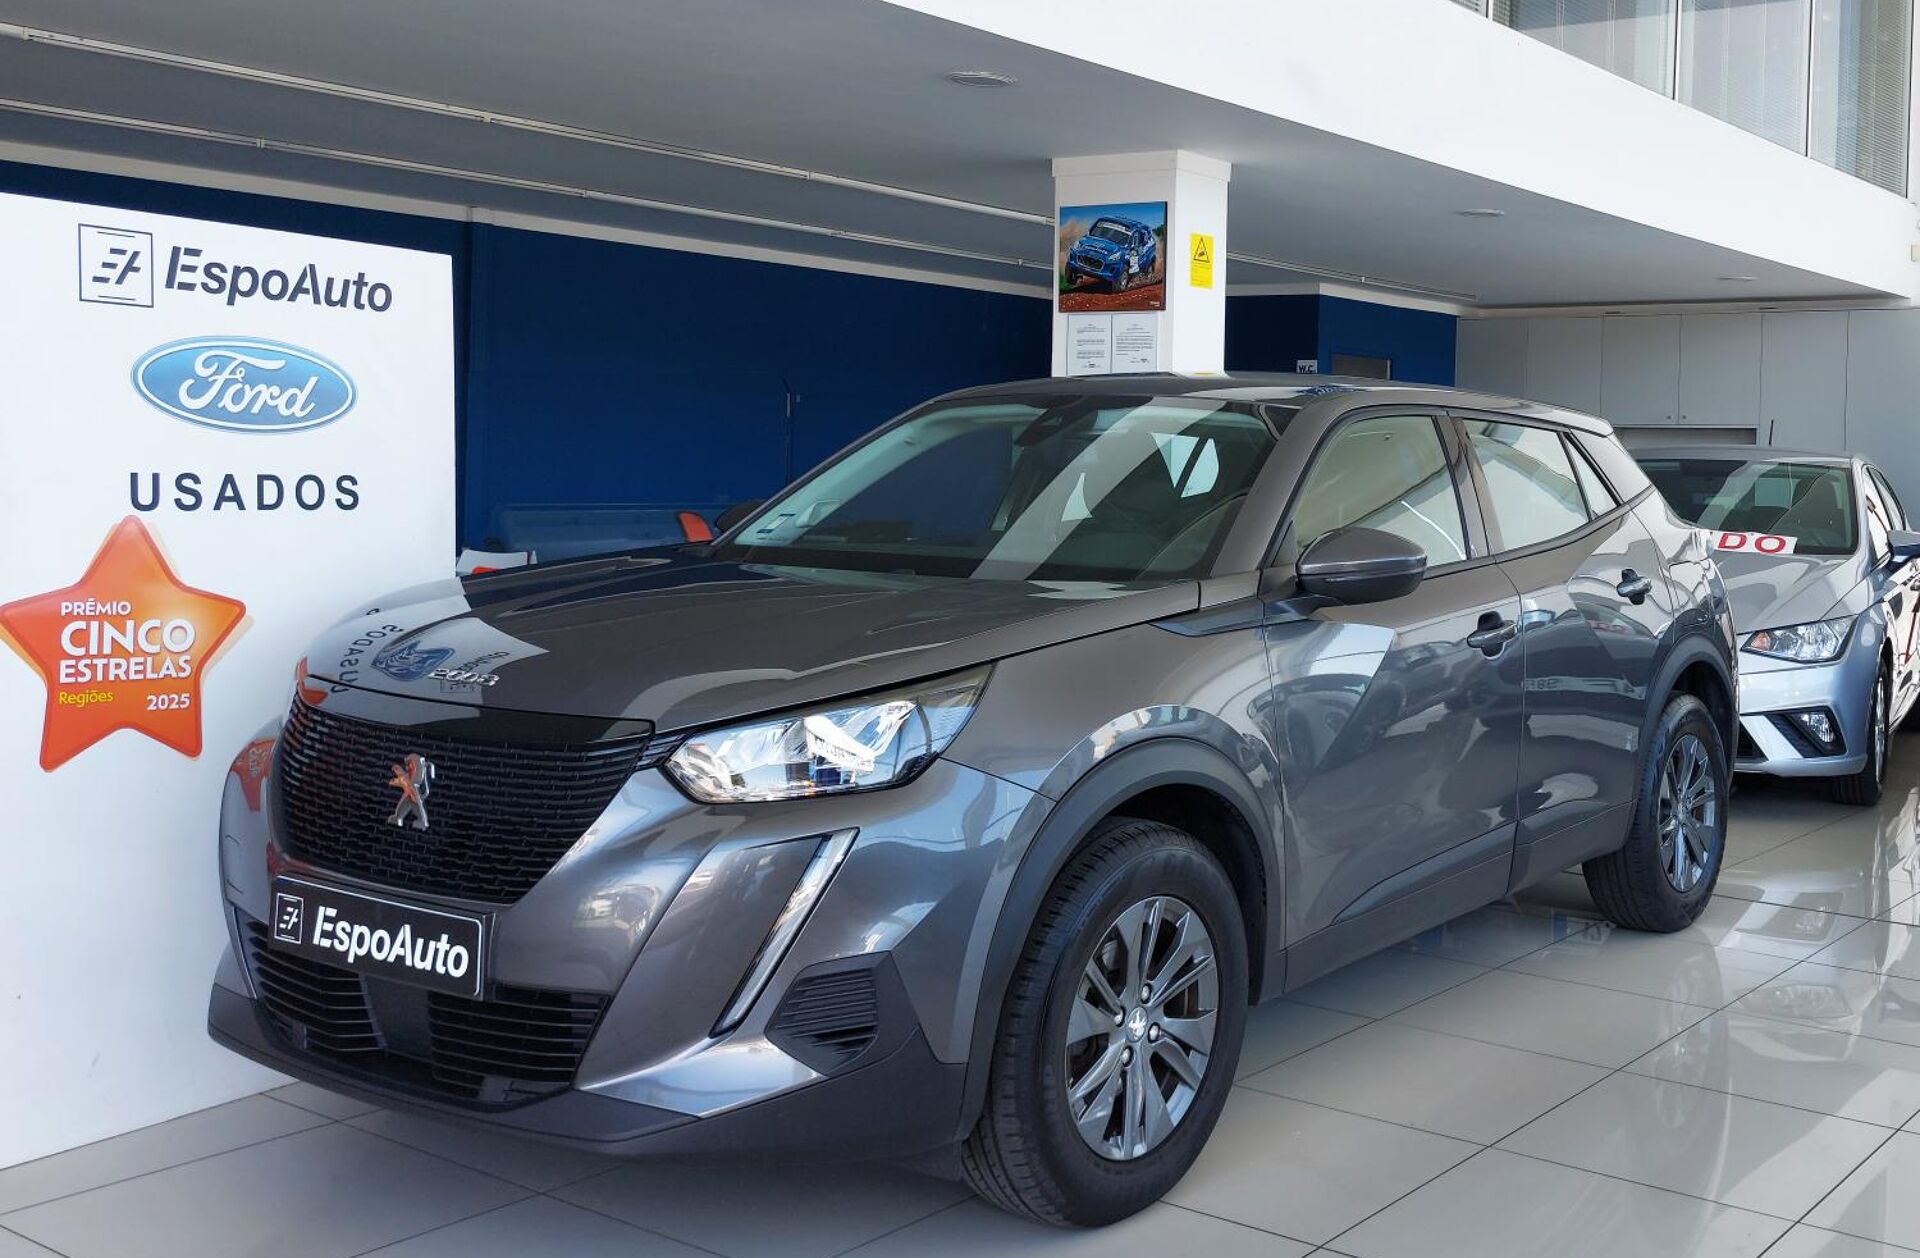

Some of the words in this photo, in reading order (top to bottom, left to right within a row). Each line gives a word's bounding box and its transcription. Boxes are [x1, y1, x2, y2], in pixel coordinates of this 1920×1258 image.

[165, 246, 392, 312] EspoAuto
[179, 350, 318, 417] Ford
[129, 472, 360, 512] USADOS
[60, 598, 132, 616] PRÉMIO
[60, 618, 196, 656] CINCO
[58, 655, 192, 684] ESTRELAS
[58, 689, 114, 708] Regiões
[146, 693, 191, 711] 2025
[312, 905, 469, 978] EspoAuto
